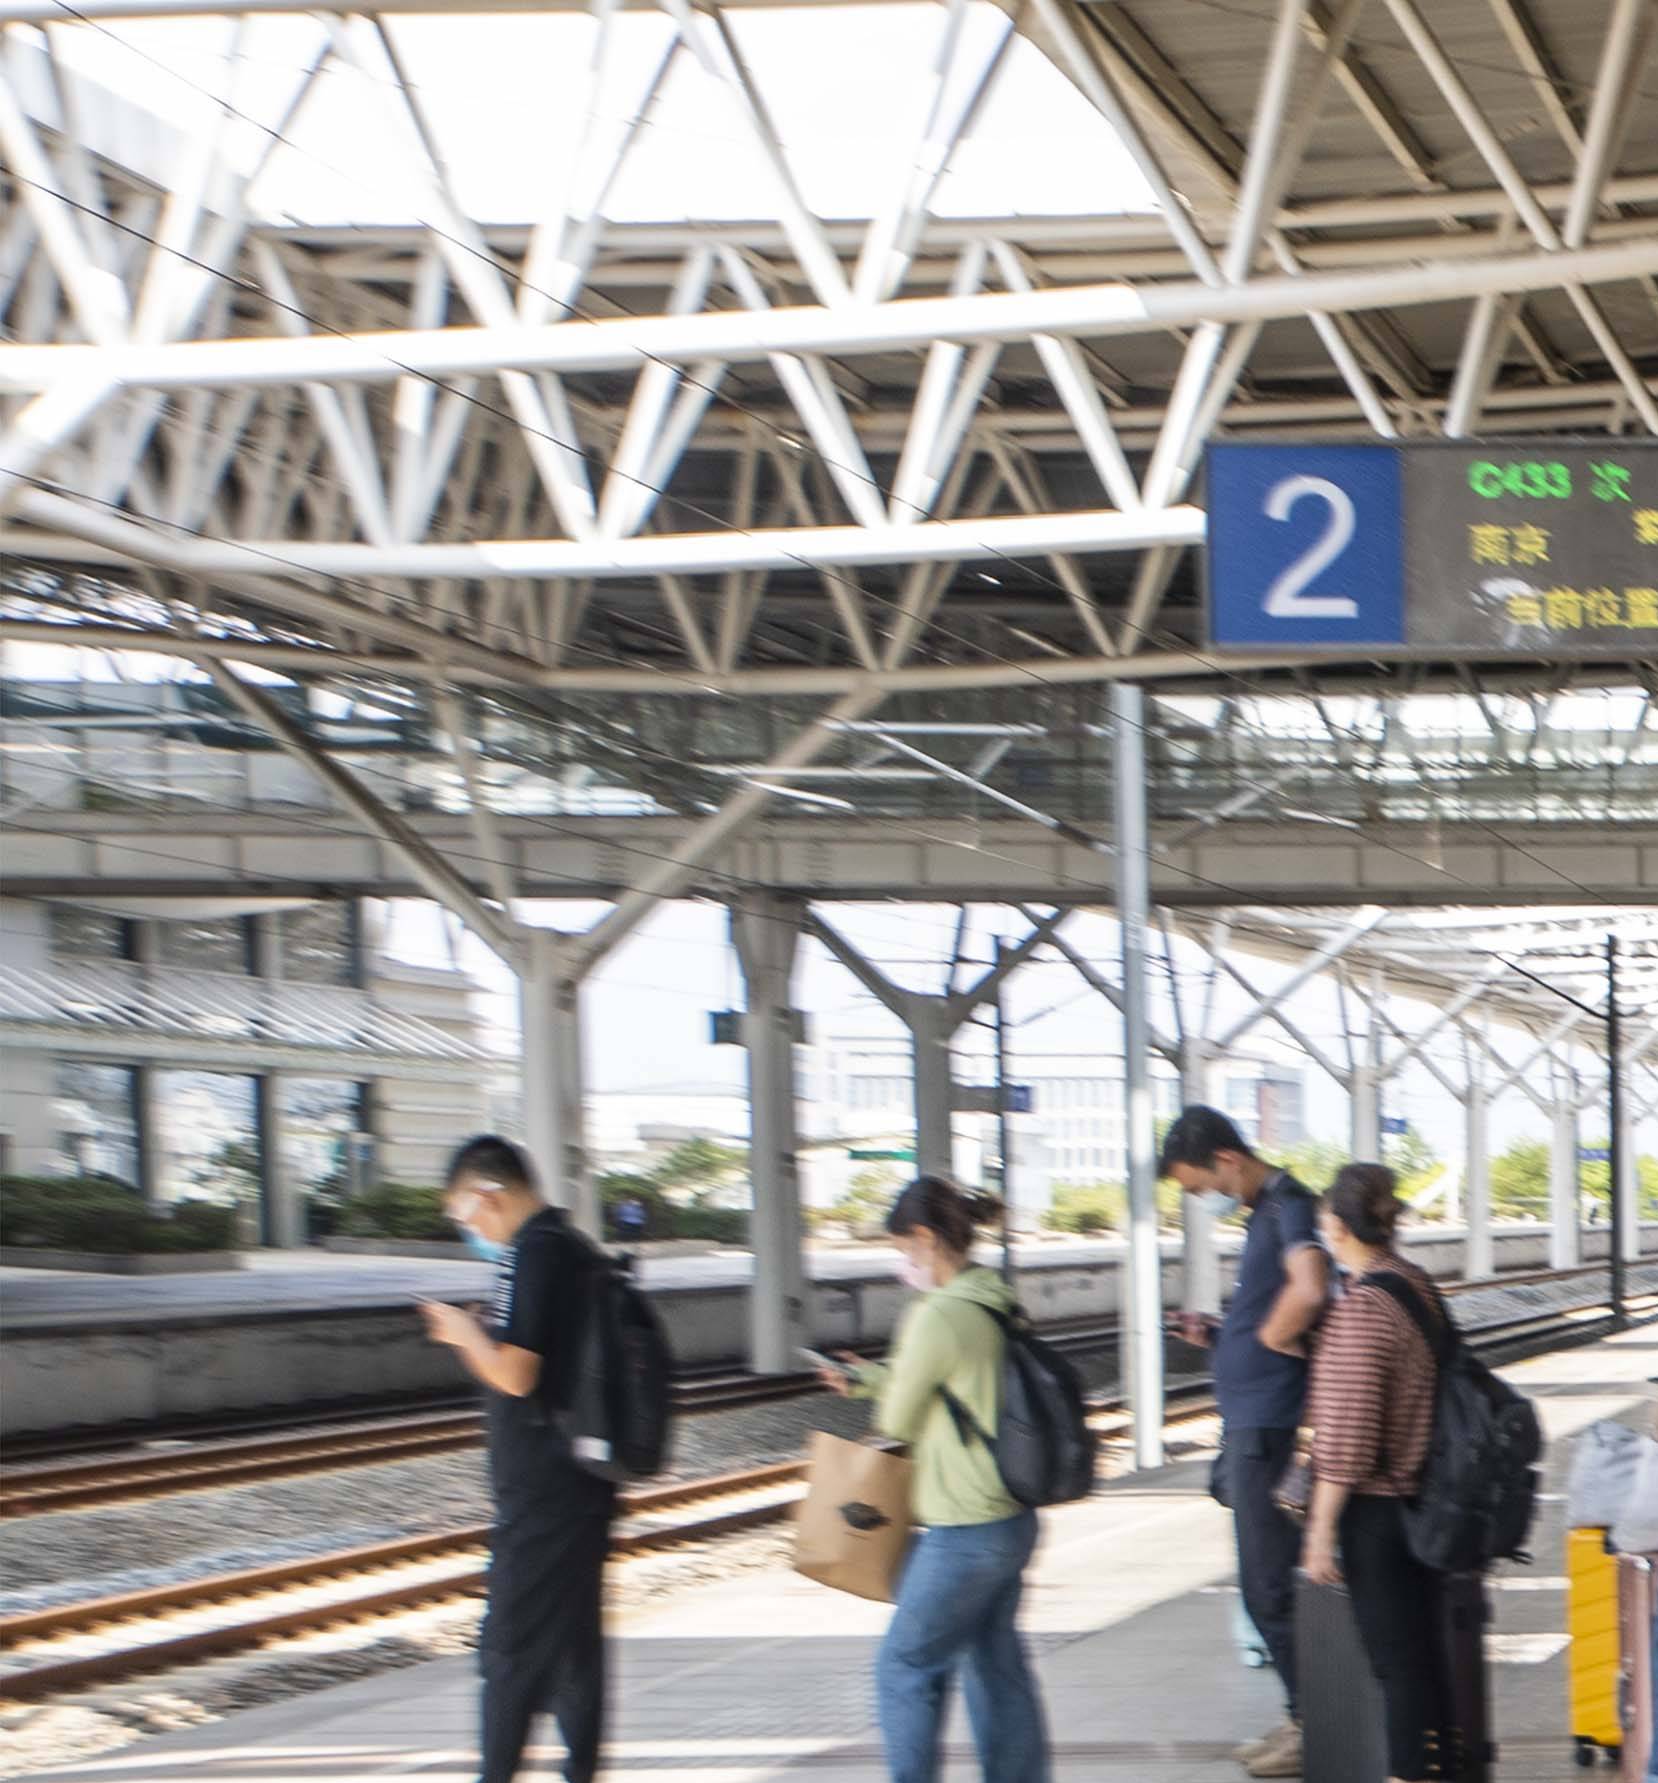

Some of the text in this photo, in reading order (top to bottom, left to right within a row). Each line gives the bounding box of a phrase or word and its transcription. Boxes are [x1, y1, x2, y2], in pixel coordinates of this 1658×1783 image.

[1588, 461, 1632, 501] 次
[1263, 474, 1358, 619] 2
[1467, 522, 1552, 566] 南京
